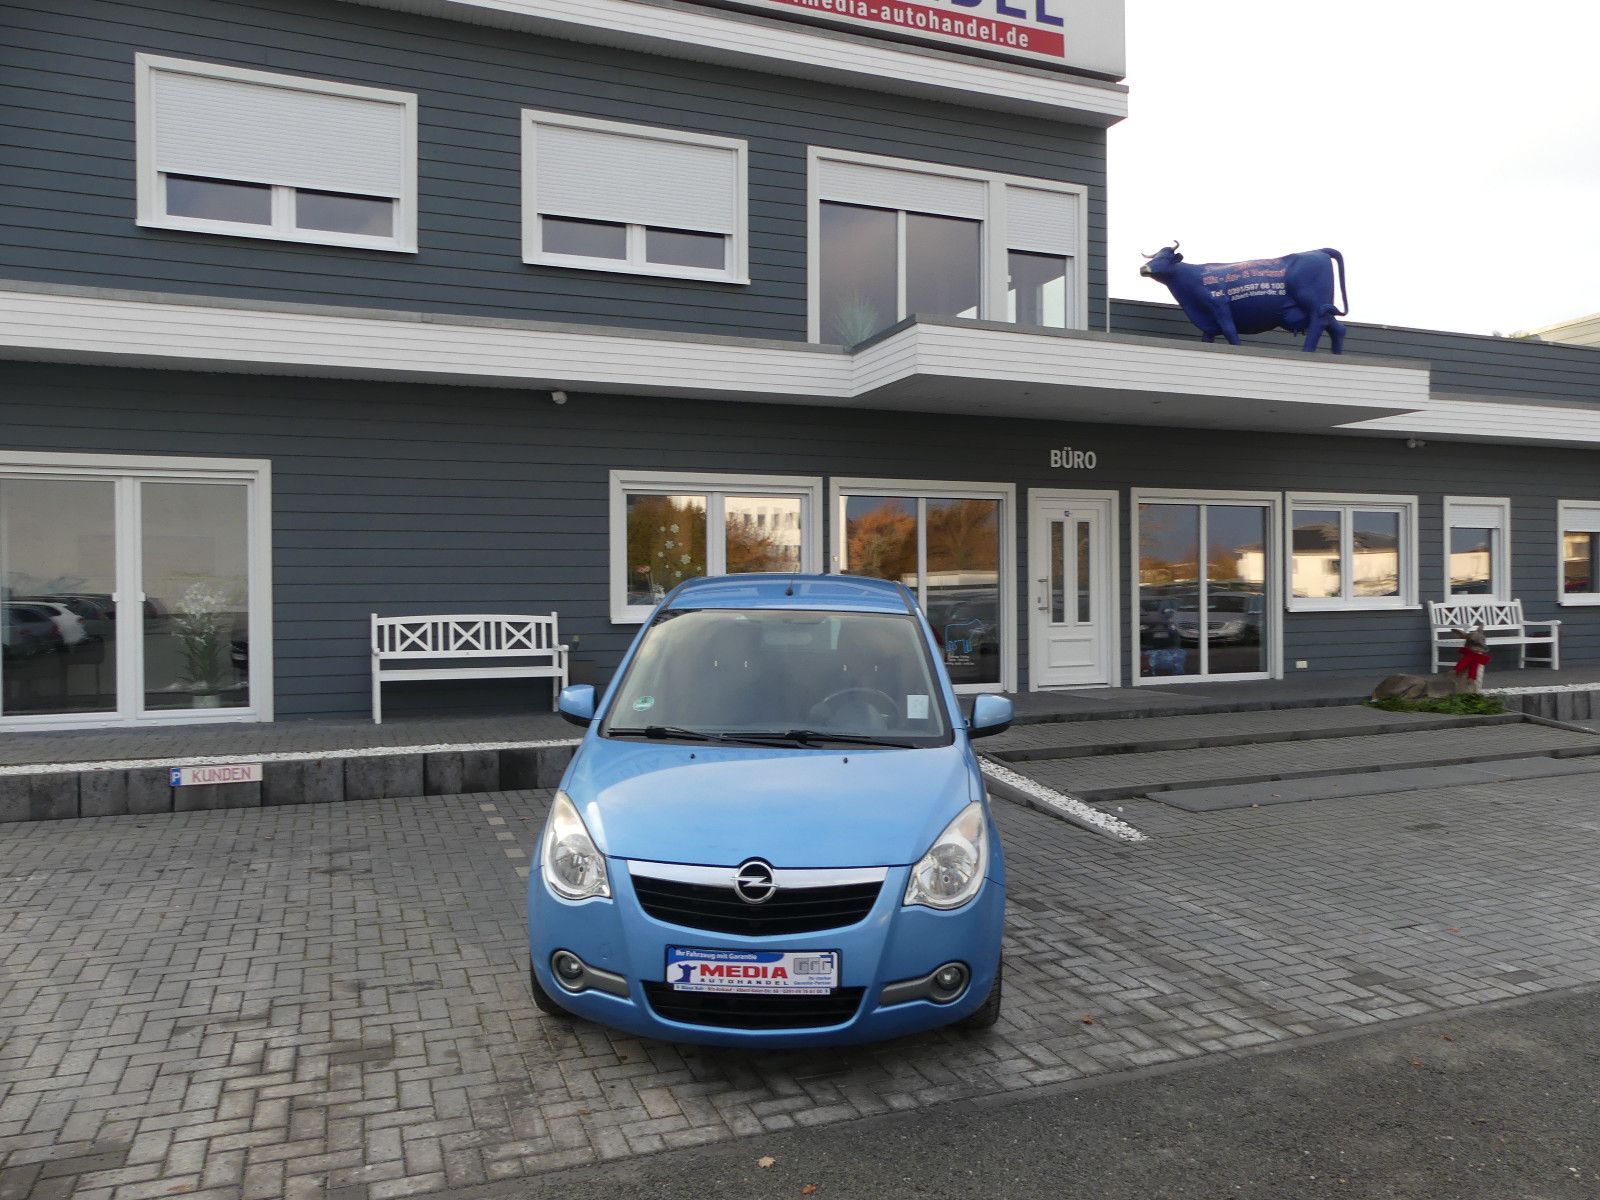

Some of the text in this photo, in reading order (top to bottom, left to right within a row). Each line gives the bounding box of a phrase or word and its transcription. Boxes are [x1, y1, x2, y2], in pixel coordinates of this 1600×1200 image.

[1050, 446, 1097, 470] BÜRO
[171, 767, 252, 783] P KUNDEN
[676, 949, 686, 957] Ihr
[686, 950, 715, 960] Fahrzeug
[728, 953, 758, 961] Garantie
[700, 964, 788, 978] MEDIA
[699, 978, 790, 986] AUTOHANDEL
